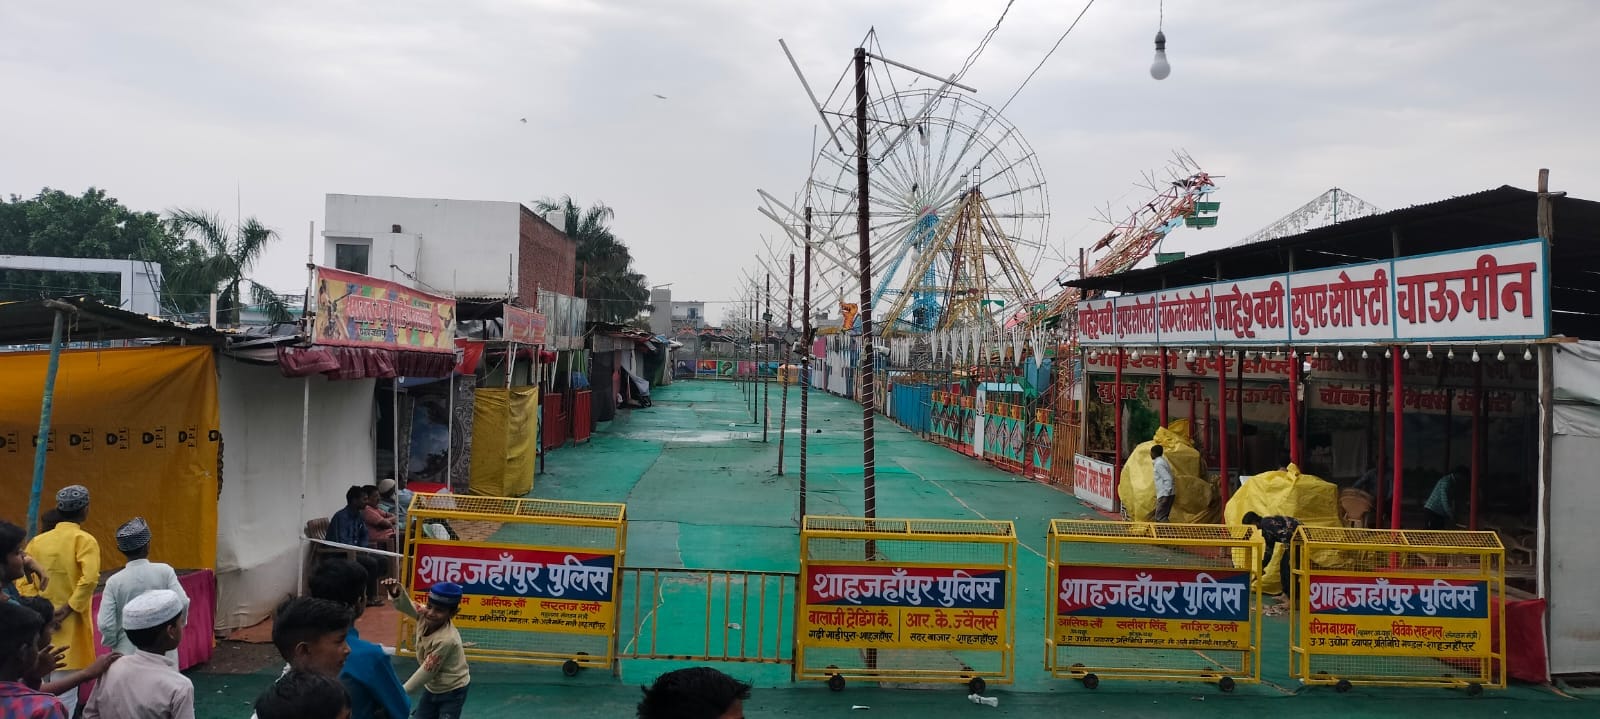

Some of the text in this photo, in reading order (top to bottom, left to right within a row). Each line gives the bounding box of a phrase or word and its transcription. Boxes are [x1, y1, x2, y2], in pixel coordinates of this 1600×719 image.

[1214, 281, 1285, 338] माहेश्वरी
[1291, 284, 1328, 335] सुपर
[1397, 254, 1536, 324] चाऊमीन
[545, 554, 613, 597] पुलिस
[936, 570, 1000, 607] पुलिस
[1180, 573, 1246, 616] पुलिस
[808, 607, 845, 625] बालाजी
[1418, 579, 1479, 616] पुलिस
